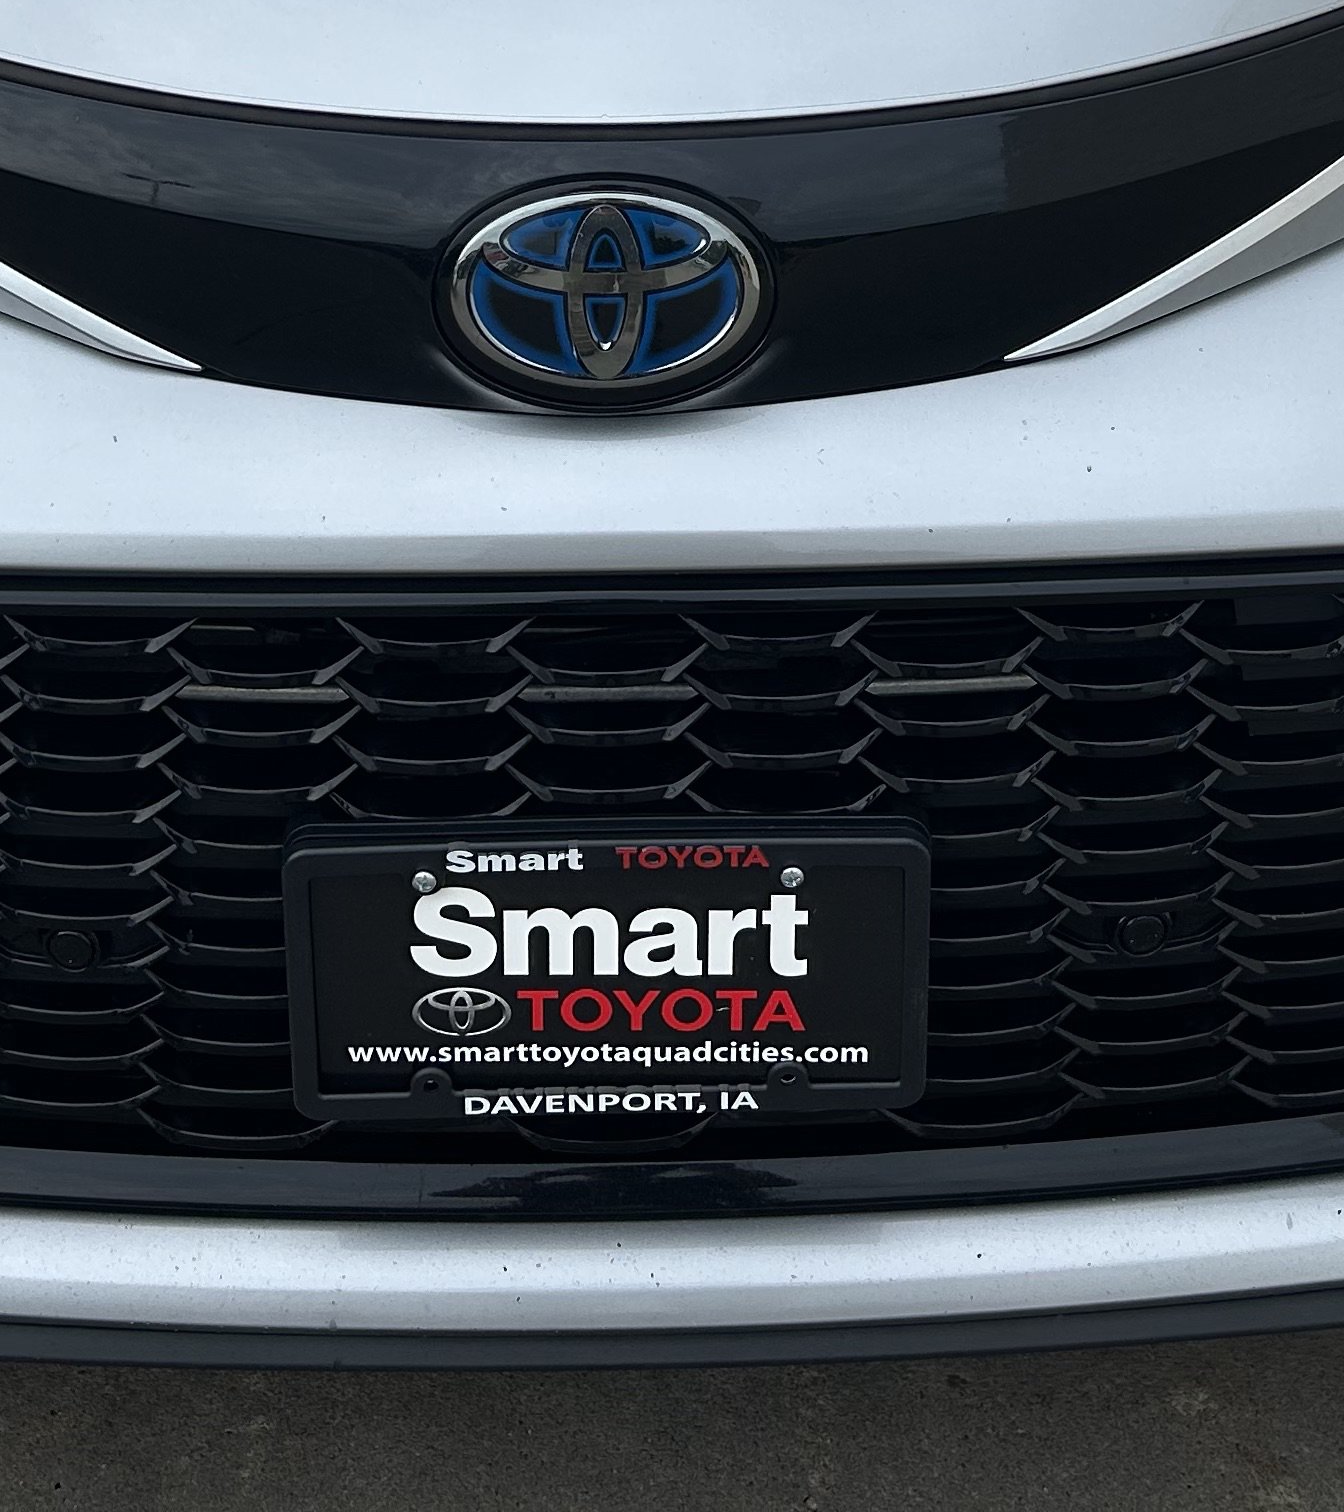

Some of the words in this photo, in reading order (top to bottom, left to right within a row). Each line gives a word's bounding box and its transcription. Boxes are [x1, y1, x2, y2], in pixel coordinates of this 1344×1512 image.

[445, 848, 584, 873] Smart
[615, 845, 770, 869] TOYOTA
[410, 887, 809, 978] Smart
[516, 988, 806, 1032] TOYOTA
[348, 1040, 869, 1068] www.smarttoyotaquadcities.com
[464, 1091, 706, 1115] DAVENPORT,
[720, 1091, 759, 1110] IA
